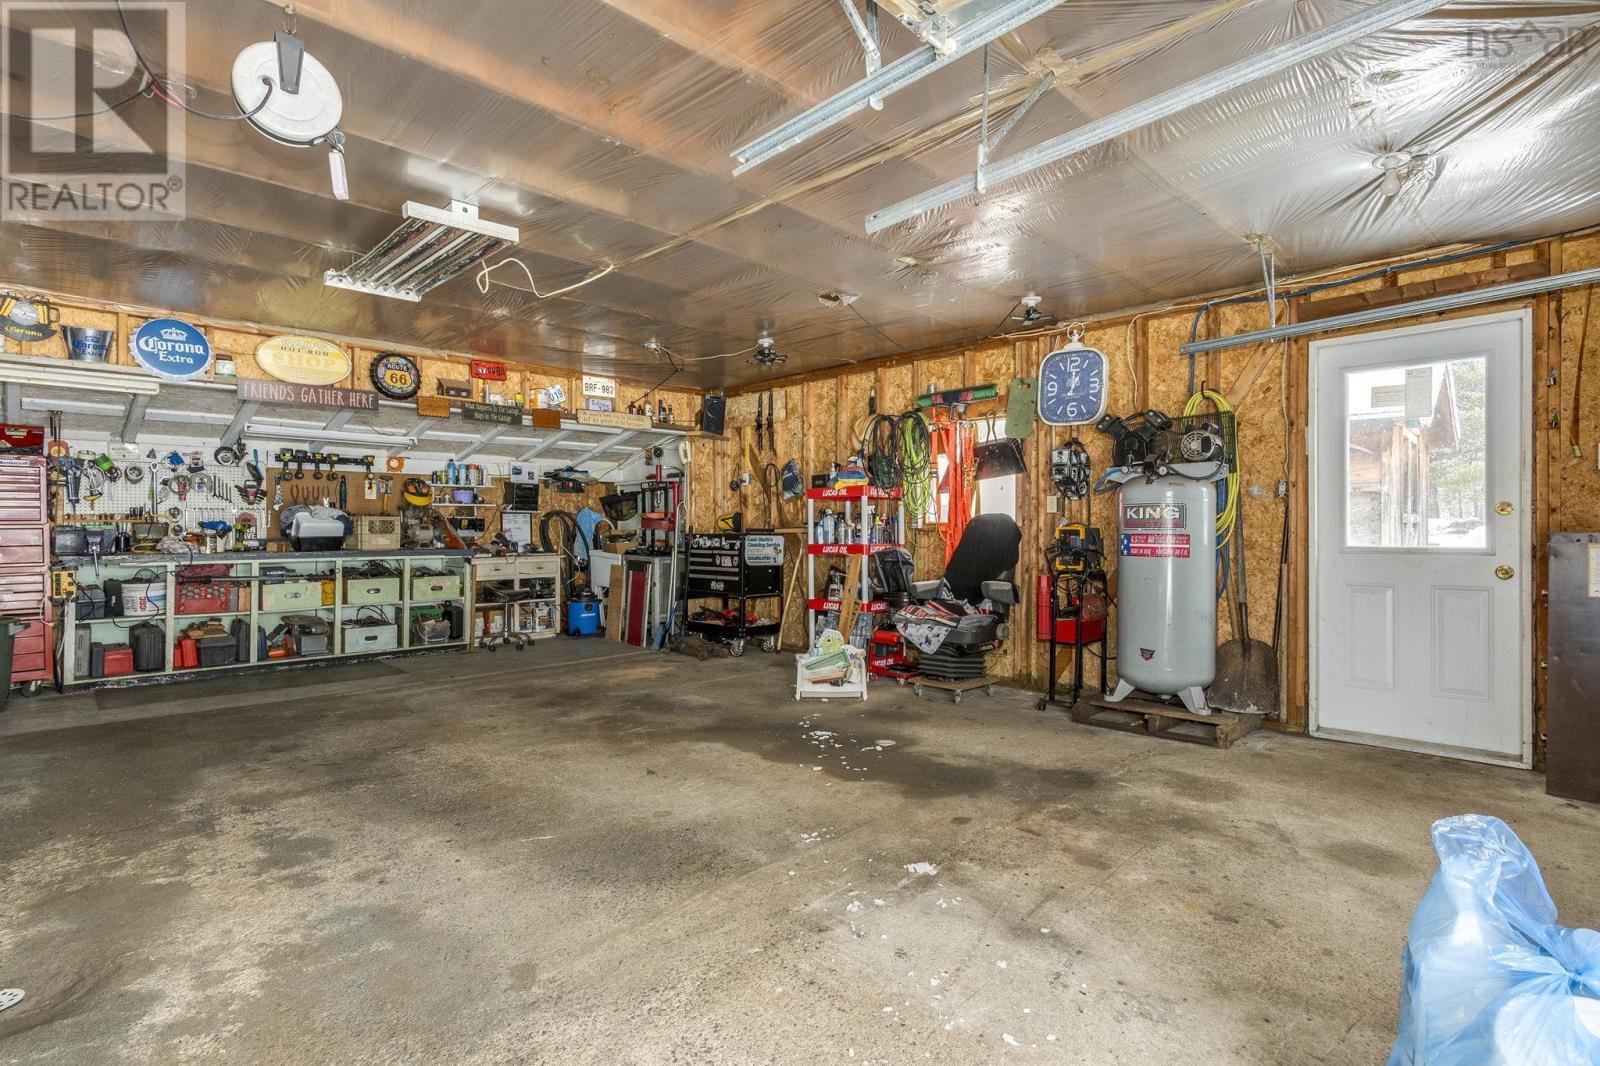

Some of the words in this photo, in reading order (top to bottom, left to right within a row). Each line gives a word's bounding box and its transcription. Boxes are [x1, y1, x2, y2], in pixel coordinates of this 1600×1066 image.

[4, 325, 43, 337] Corona
[139, 336, 205, 356] Corona
[308, 349, 329, 357] ROD
[159, 350, 194, 365] Extra
[1066, 356, 1081, 372] 12
[387, 362, 408, 373] ROUTE
[389, 372, 408, 386] 66
[1089, 377, 1100, 393] 3
[243, 381, 295, 402] FRIENDS
[301, 387, 345, 406] GATHER
[349, 393, 374, 409] HERE
[584, 382, 615, 396] BRF-982
[1047, 381, 1058, 397] 9
[1066, 401, 1077, 417] 6
[822, 488, 839, 496] LUCAS
[1126, 507, 1180, 520] KING
[822, 545, 839, 553] LUCAS
[839, 545, 848, 553] OIL
